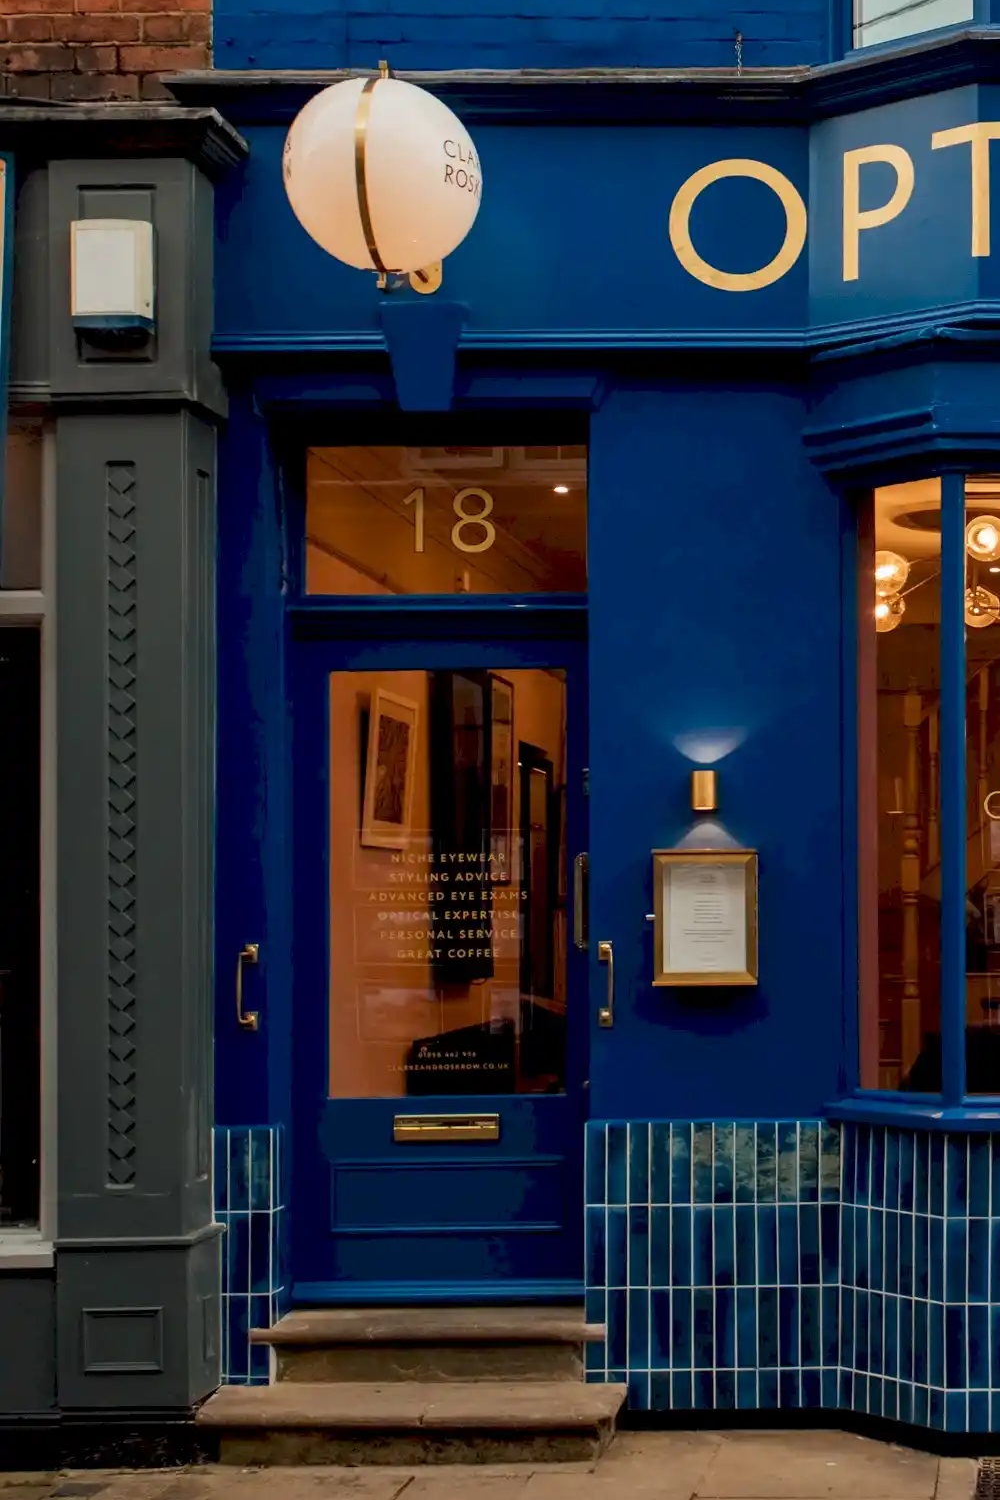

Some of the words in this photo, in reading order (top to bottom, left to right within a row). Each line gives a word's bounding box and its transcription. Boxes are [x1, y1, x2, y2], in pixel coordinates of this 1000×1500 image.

[402, 487, 496, 553] 18
[391, 853, 435, 863] NICHE
[440, 853, 505, 863] EYEWEAR
[389, 873, 450, 882] STYLING
[455, 872, 507, 882] ADVICE
[368, 892, 445, 901] ADVANCED
[451, 892, 475, 900] EYE
[481, 891, 528, 900] EXAMS
[378, 911, 439, 921] OPTICAL
[444, 911, 520, 920] EXPERTISE
[380, 930, 454, 940] PERSONAL
[459, 930, 518, 939] SERVICE
[397, 949, 442, 959] GREAT
[447, 949, 501, 958] COFFEE
